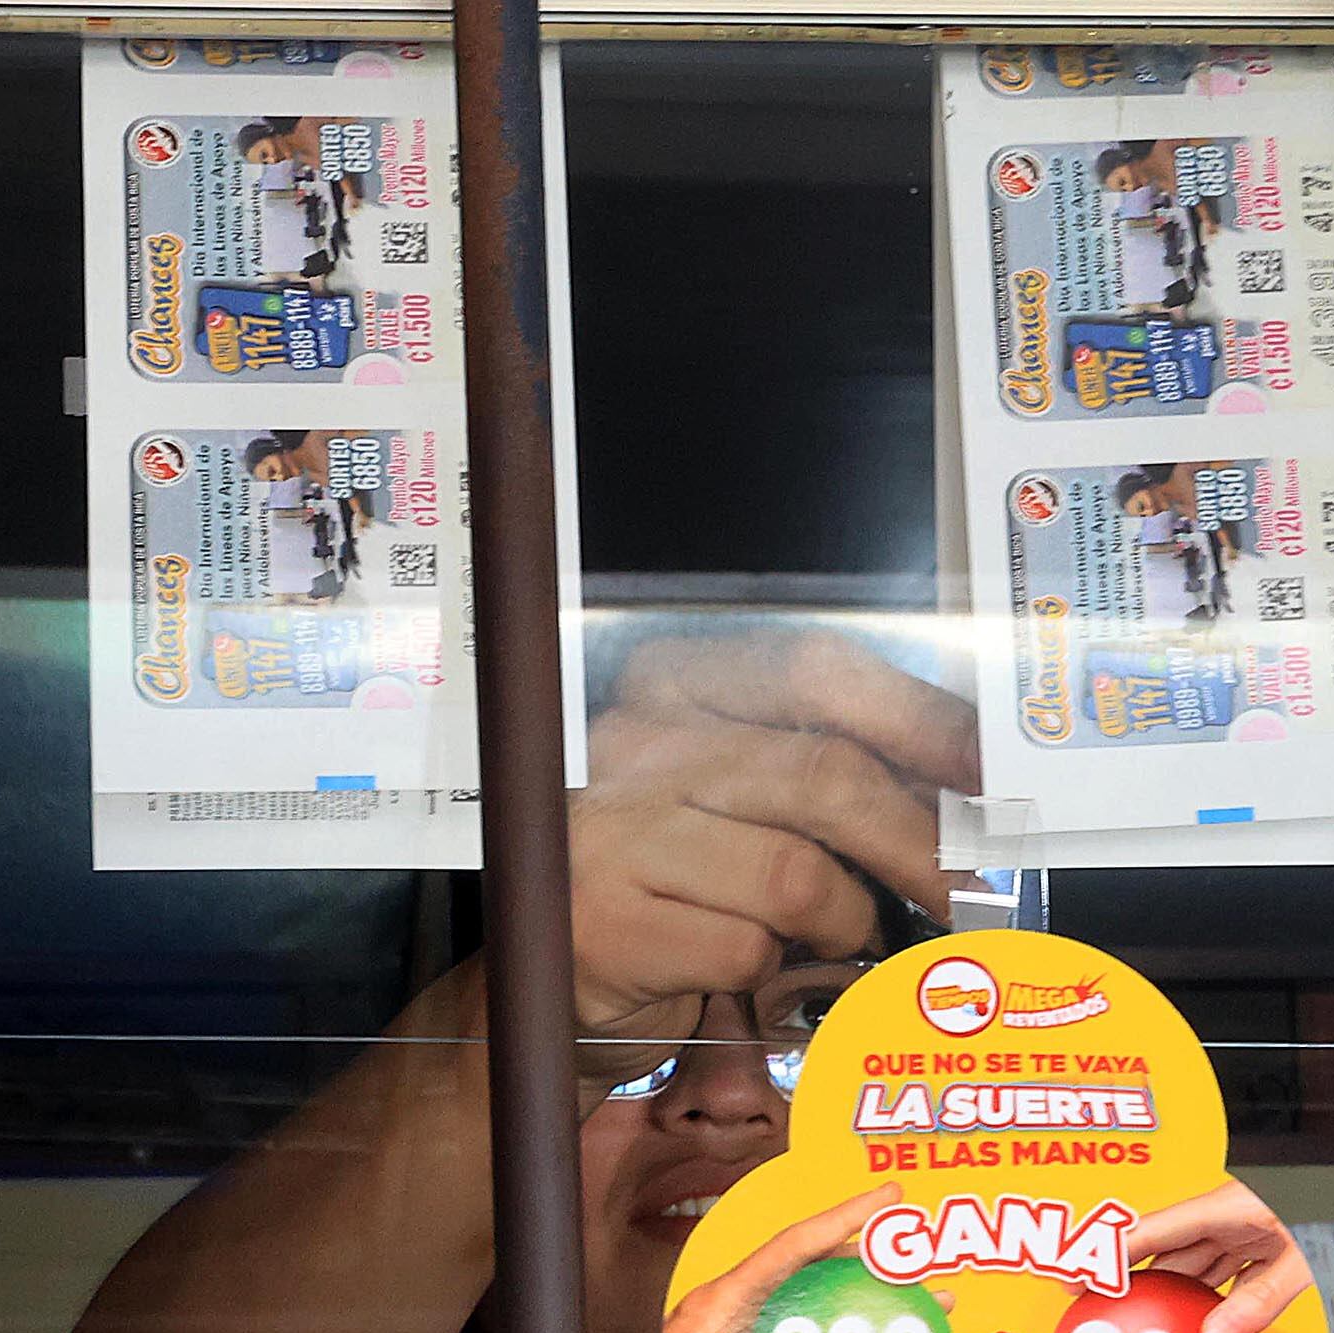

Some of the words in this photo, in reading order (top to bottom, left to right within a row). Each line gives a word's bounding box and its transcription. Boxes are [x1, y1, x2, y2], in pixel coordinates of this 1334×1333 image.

[319, 122, 343, 180] SORTEO
[342, 122, 373, 172] 6850
[1196, 144, 1228, 197] 6850
[1173, 145, 1199, 206] SORTEO
[133, 234, 182, 370] Chances
[240, 315, 287, 368] 1147
[1003, 268, 1049, 410] Chances
[1145, 319, 1181, 401] 8989-1147
[1105, 347, 1152, 403] 1147
[327, 437, 352, 498] SORTEO
[351, 437, 382, 489] 6850
[1194, 469, 1220, 531] SORTEO
[1217, 467, 1249, 521] 6850
[139, 554, 189, 696] Chances
[1023, 594, 1069, 739] Chances
[1125, 674, 1173, 731] 1147
[1003, 993, 1110, 1028] REVENTADOS
[1005, 983, 1079, 1012] MEGA
[864, 1053, 925, 1076] QUE
[933, 1053, 976, 1075] NO
[985, 1053, 1022, 1073] SE
[1029, 1053, 1067, 1073] TE
[1075, 1054, 1150, 1074] VAYA
[854, 1083, 934, 1130] LA
[939, 1083, 1156, 1130] SUERTE
[866, 1142, 918, 1172] DE
[928, 1141, 1001, 1169] LAS
[1012, 1140, 1152, 1166] MANOS
[863, 1196, 1136, 1296] GANÁ
